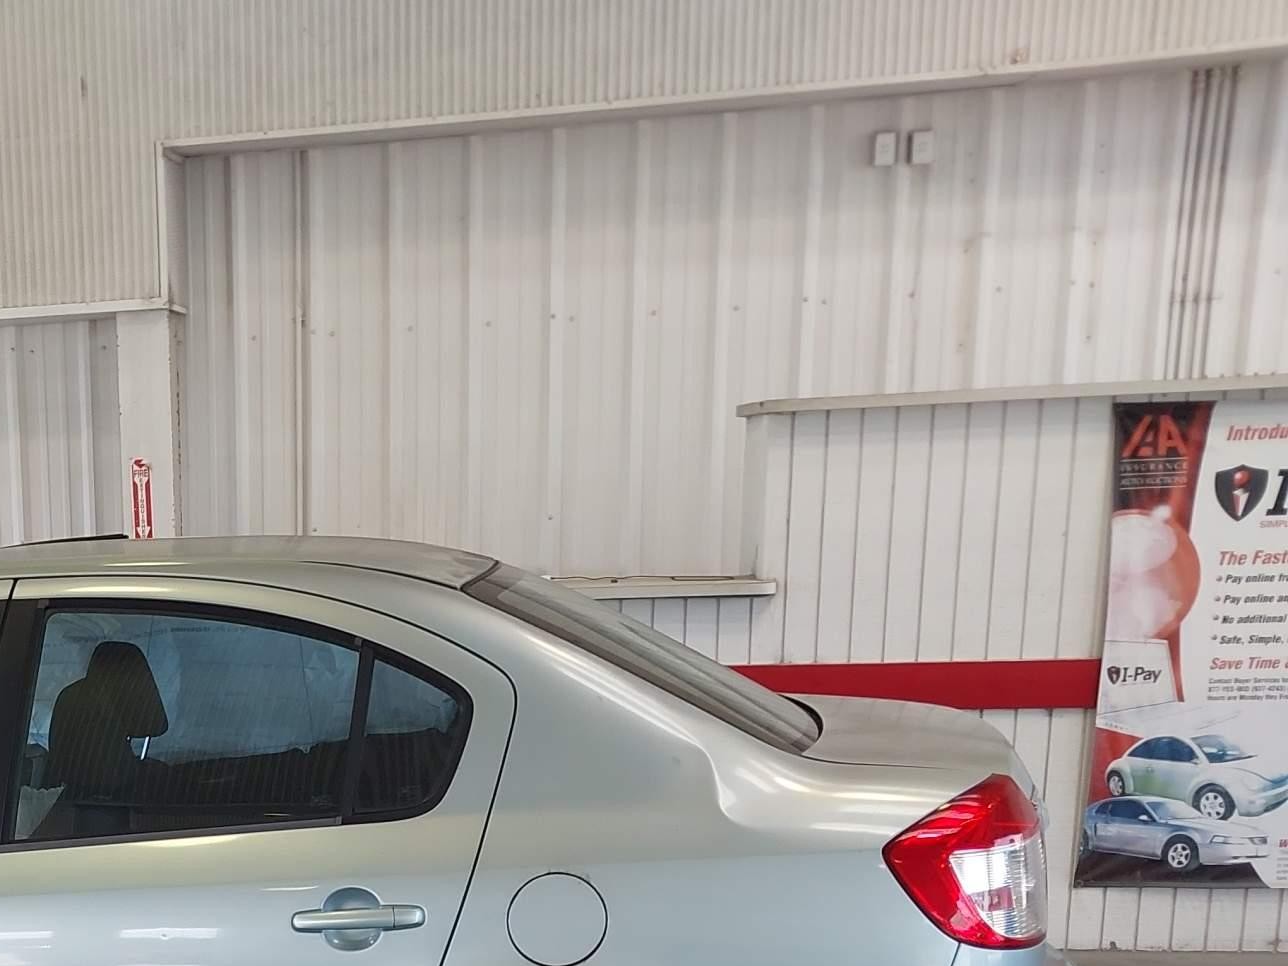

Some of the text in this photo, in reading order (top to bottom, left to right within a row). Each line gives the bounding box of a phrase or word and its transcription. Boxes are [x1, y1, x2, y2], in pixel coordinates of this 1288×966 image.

[1120, 461, 1188, 472] INSURANCE
[133, 469, 149, 478] FIRE
[1219, 549, 1288, 566] The Fast
[1224, 574, 1243, 584] Pay
[1245, 572, 1275, 583] online
[1223, 594, 1242, 605] Pay
[1243, 593, 1275, 604] online
[1221, 613, 1287, 624] No additional
[1219, 635, 1245, 645] Safe,
[1248, 633, 1285, 646] Simple,
[1210, 657, 1243, 670] Save
[1247, 656, 1281, 670] Time
[1121, 666, 1162, 683] I-Pay
